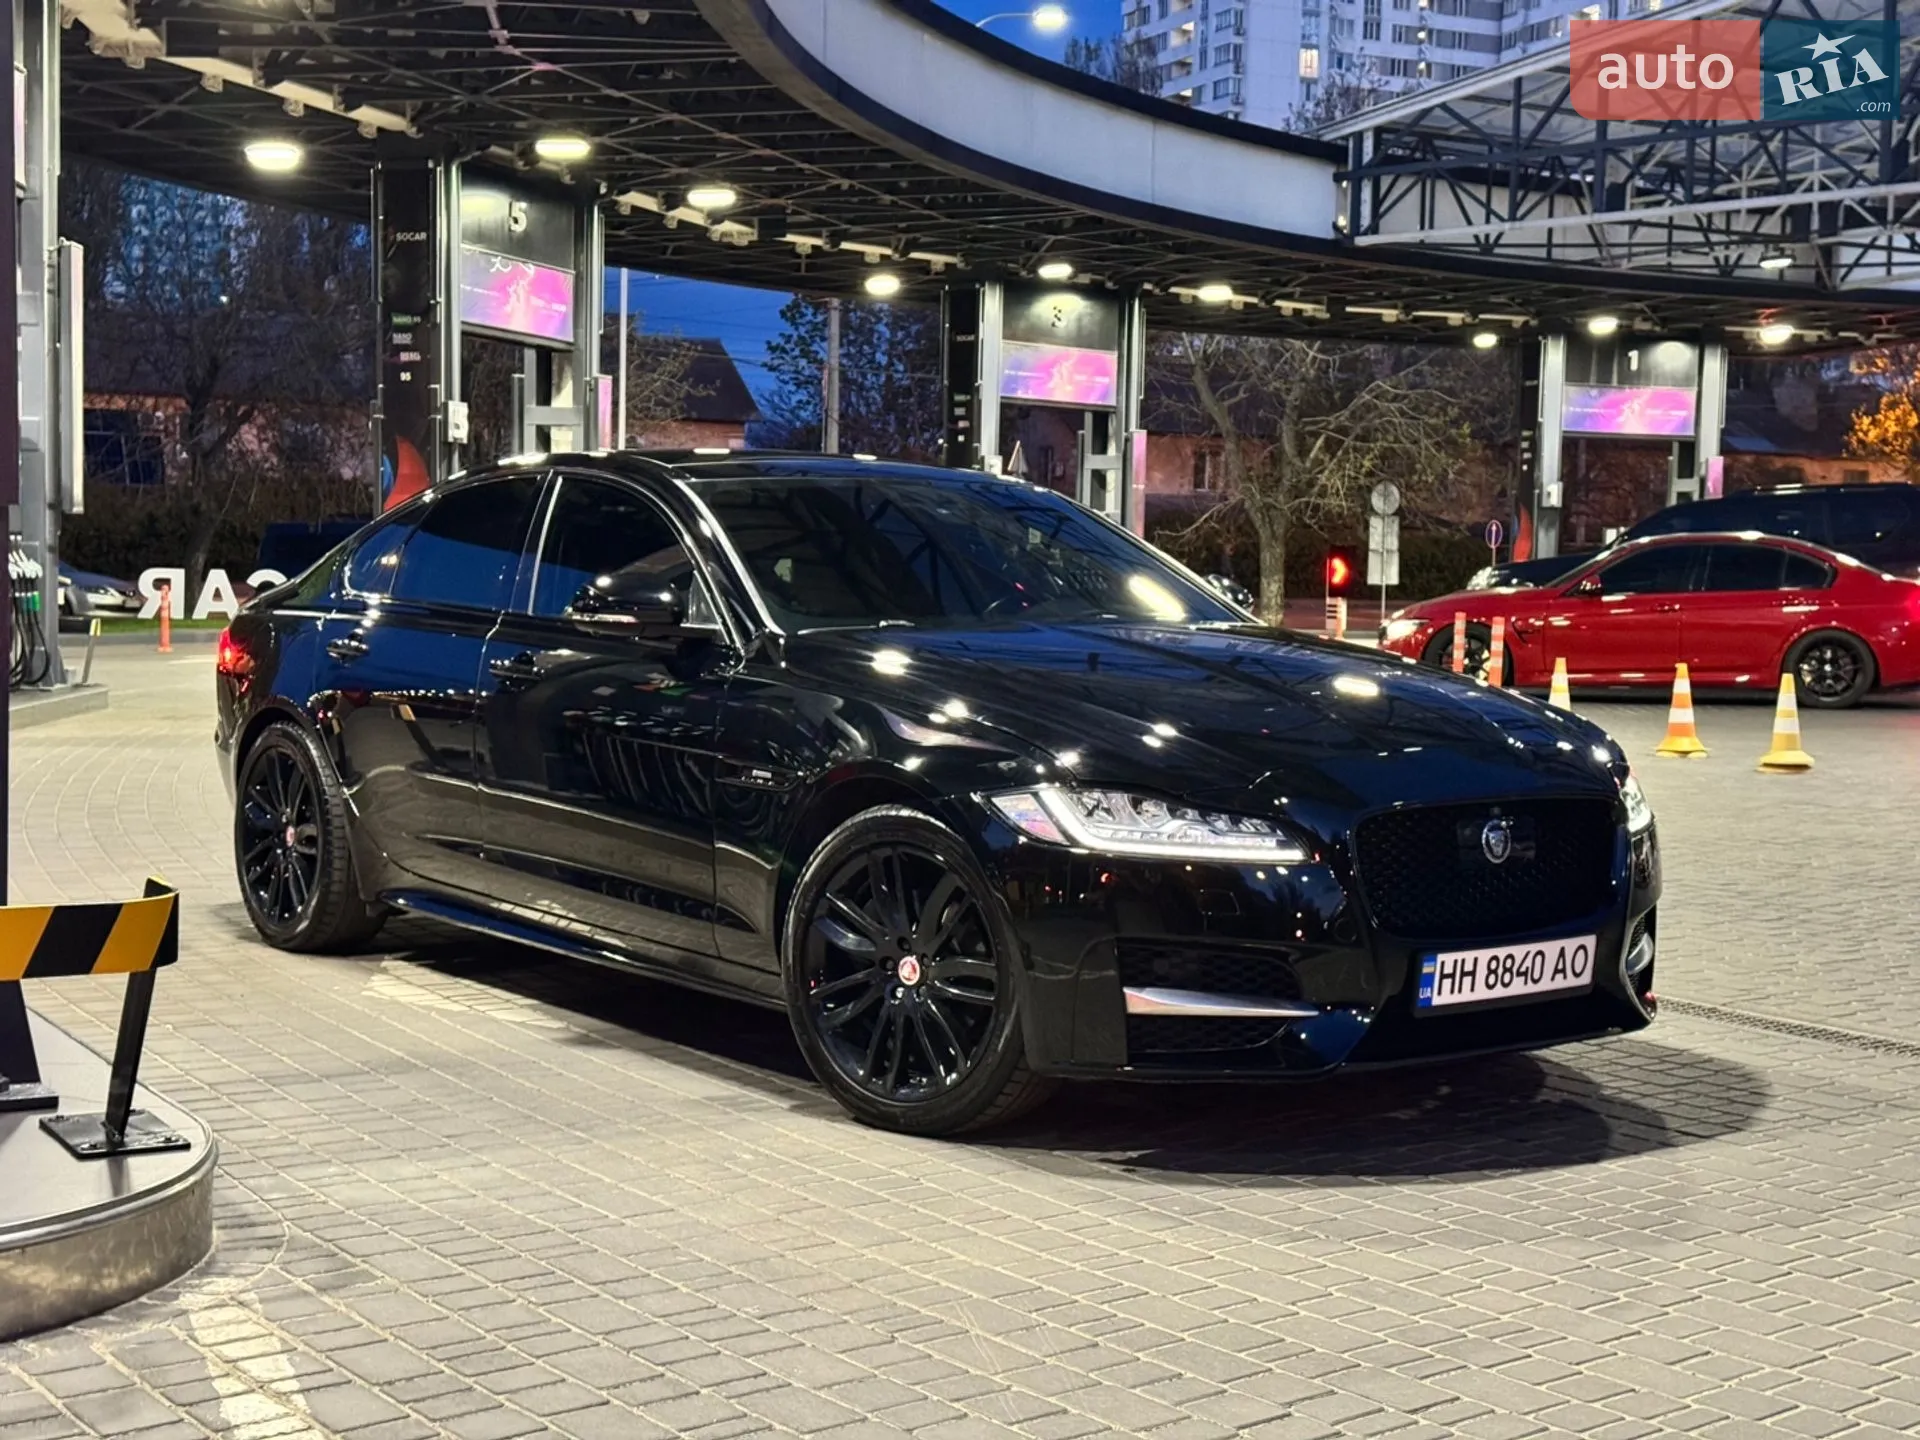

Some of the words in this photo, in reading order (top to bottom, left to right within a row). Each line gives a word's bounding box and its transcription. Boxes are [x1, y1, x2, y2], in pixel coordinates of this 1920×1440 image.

[510, 201, 527, 232] 5
[395, 231, 427, 241] SOCAR
[1628, 350, 1639, 371] 1
[1437, 956, 1479, 996] HH
[1484, 949, 1546, 990] 8840
[1550, 943, 1589, 981] AO
[1419, 987, 1432, 998] UA
